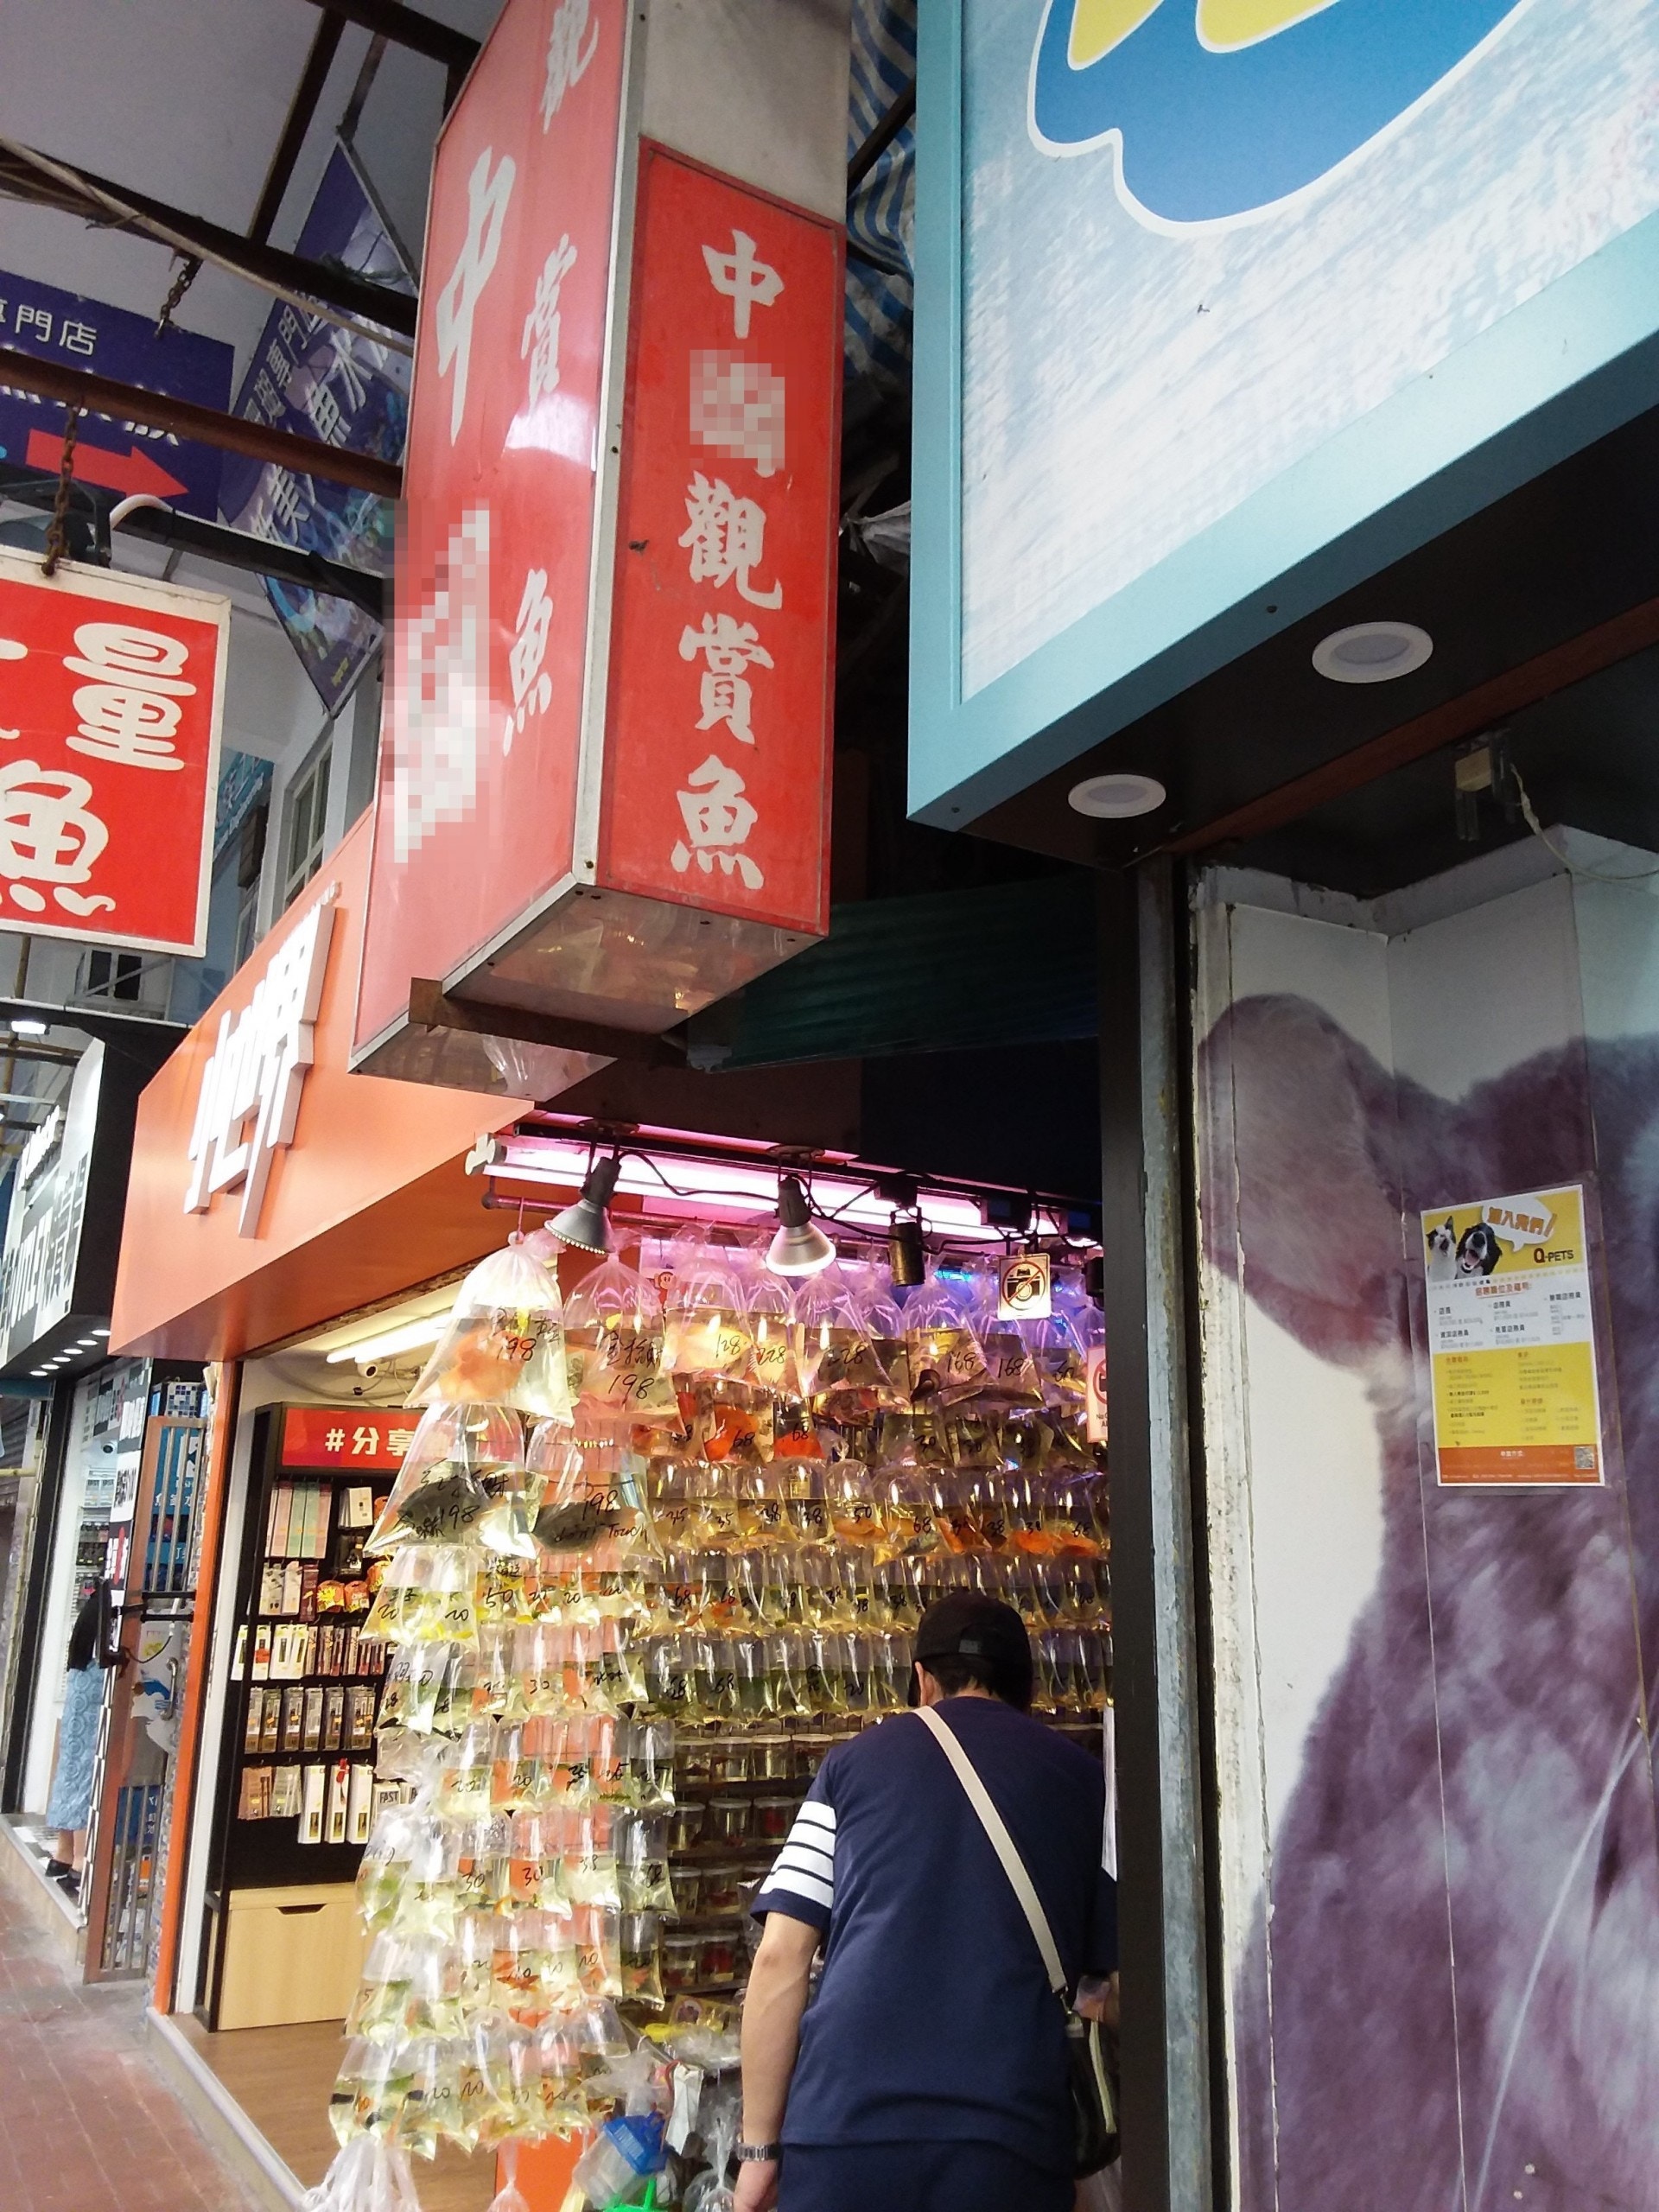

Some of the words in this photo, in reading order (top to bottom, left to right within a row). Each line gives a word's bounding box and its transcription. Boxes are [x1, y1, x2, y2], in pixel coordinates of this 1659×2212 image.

[0, 299, 98, 356] 門店
[671, 228, 785, 890] 中觀賞魚
[1534, 1248, 1574, 1263] Q-PETS
[496, 1337, 537, 1362] 198
[715, 1334, 741, 1358] 128
[757, 1345, 786, 1366] 228
[827, 1345, 867, 1366] 228
[947, 1351, 976, 1372] 168
[998, 1357, 1026, 1378] 168
[607, 1374, 656, 1403] 198
[733, 1430, 756, 1447] 68
[791, 1424, 809, 1441] 68
[582, 1490, 619, 1520] 198
[854, 1506, 872, 1523] 50
[441, 1504, 480, 1529] 198
[666, 1508, 688, 1525] 35
[715, 1512, 734, 1528] 35
[913, 1517, 931, 1534] 68
[486, 1586, 513, 1607] 50
[563, 1592, 580, 1604] 20
[531, 1680, 550, 1694] 30
[380, 1791, 399, 1804] FAST
